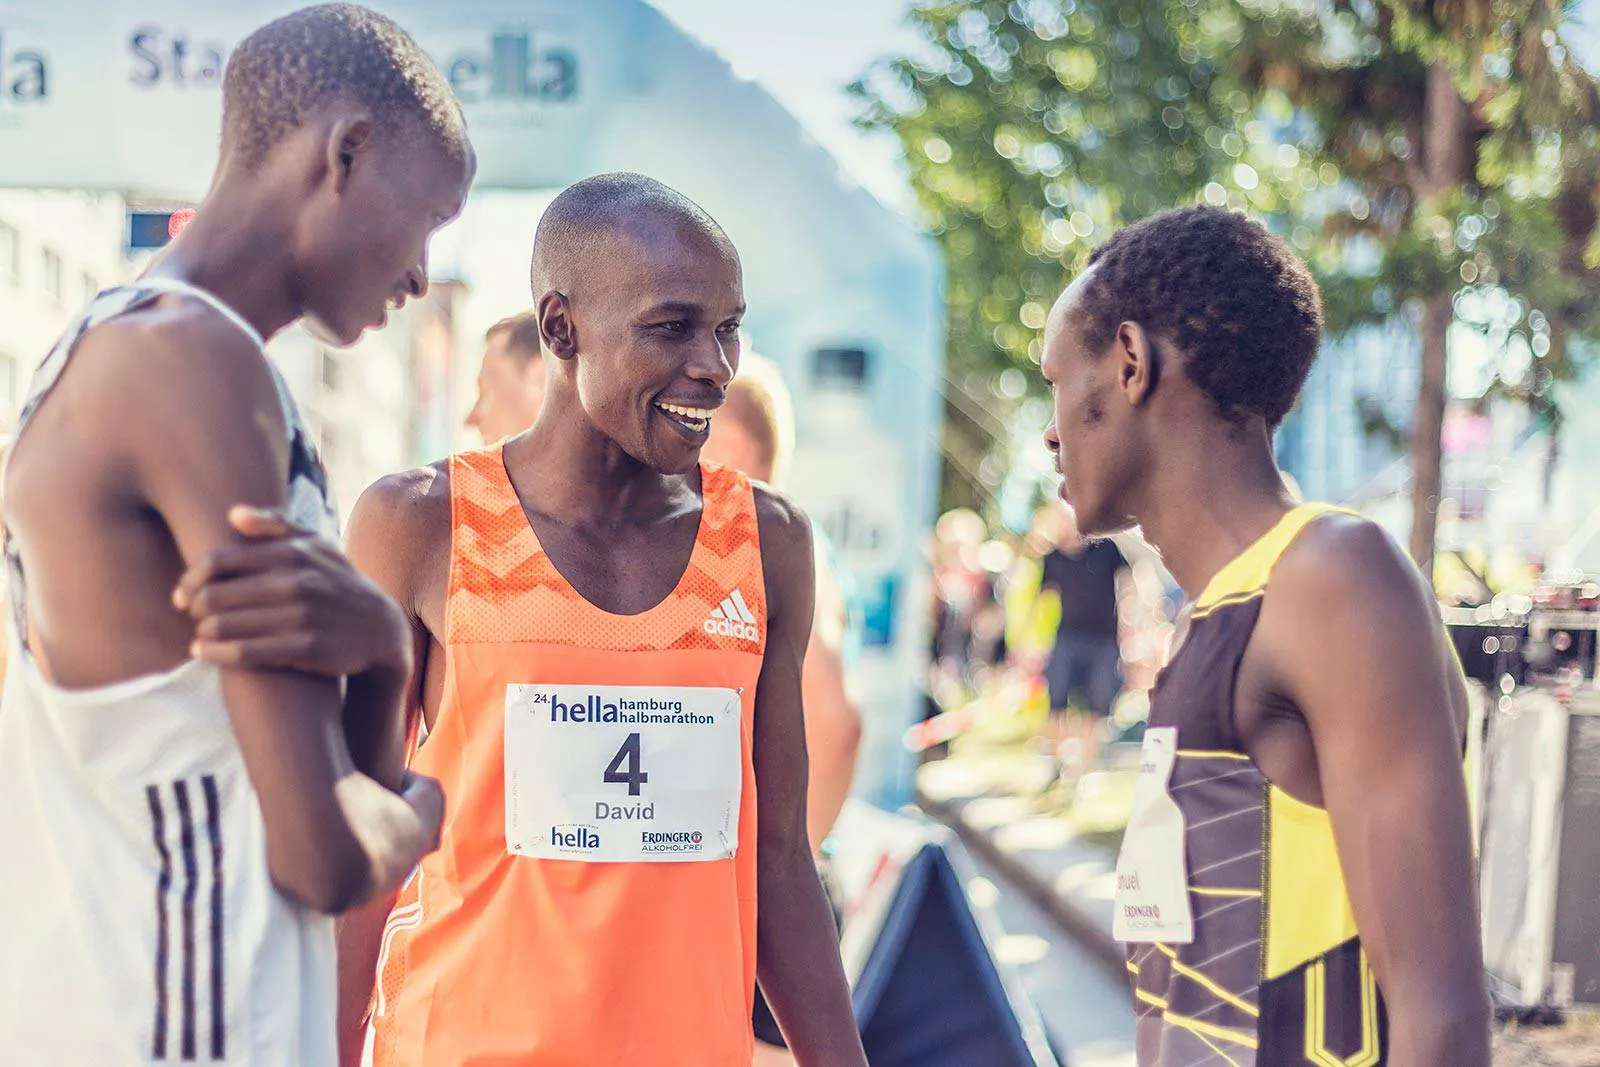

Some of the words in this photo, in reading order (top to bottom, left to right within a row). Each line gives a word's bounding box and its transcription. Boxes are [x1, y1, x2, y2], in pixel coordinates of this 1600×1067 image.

[551, 694, 618, 722] hella
[620, 698, 682, 713] hamburg
[620, 711, 714, 724] halbmarathon
[603, 733, 648, 796] 4
[595, 802, 654, 820] David
[551, 826, 600, 848] hella
[642, 831, 691, 843] ERDINGER
